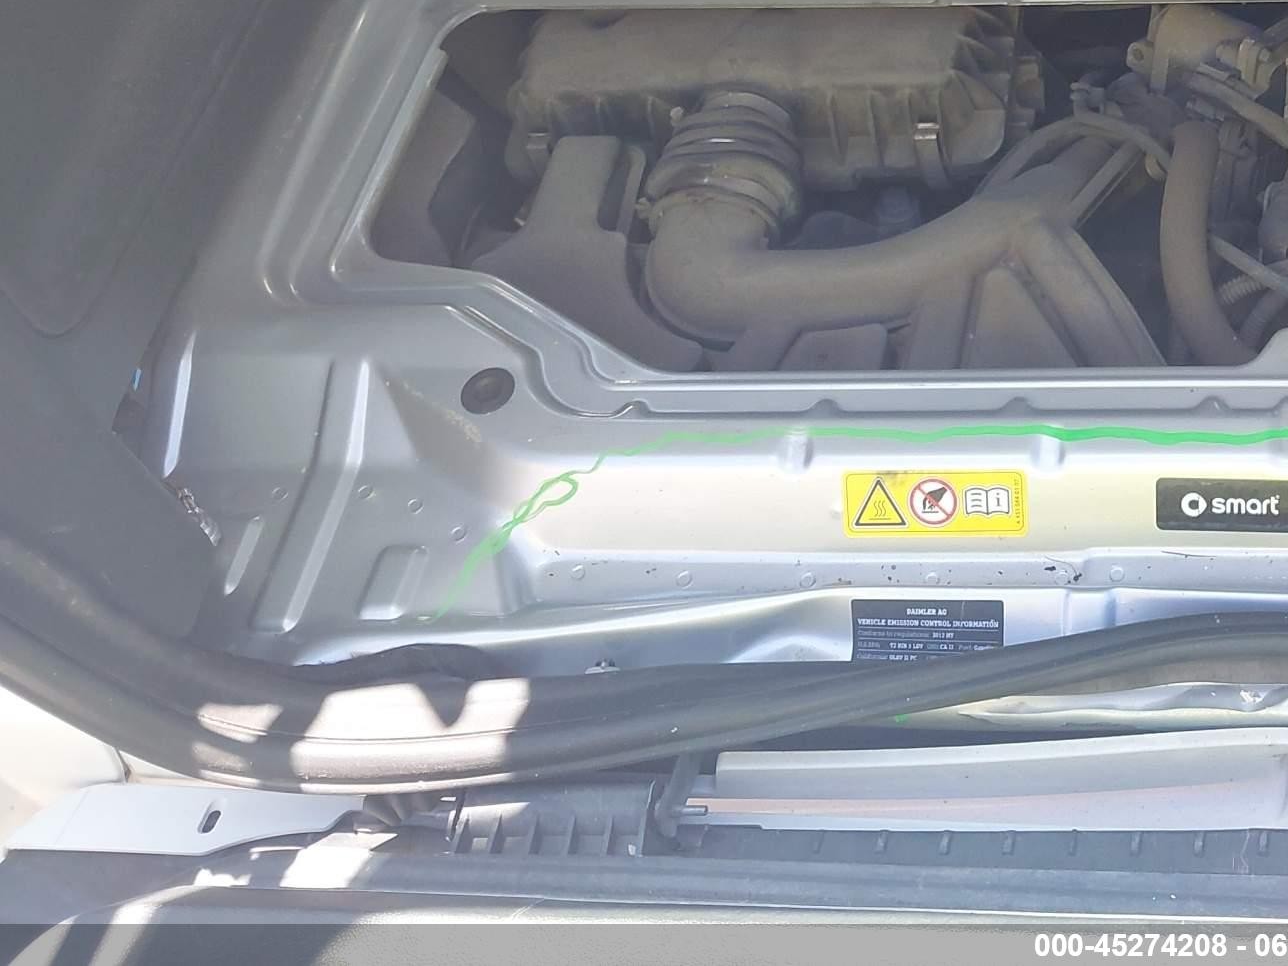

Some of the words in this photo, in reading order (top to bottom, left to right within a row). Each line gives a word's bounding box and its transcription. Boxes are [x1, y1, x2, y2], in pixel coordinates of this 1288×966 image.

[1211, 495, 1279, 515] smart
[906, 608, 936, 616] DAIMLER
[857, 618, 886, 626] VEHICLE
[887, 619, 919, 627] EMISSION
[920, 620, 952, 628] CONTROL
